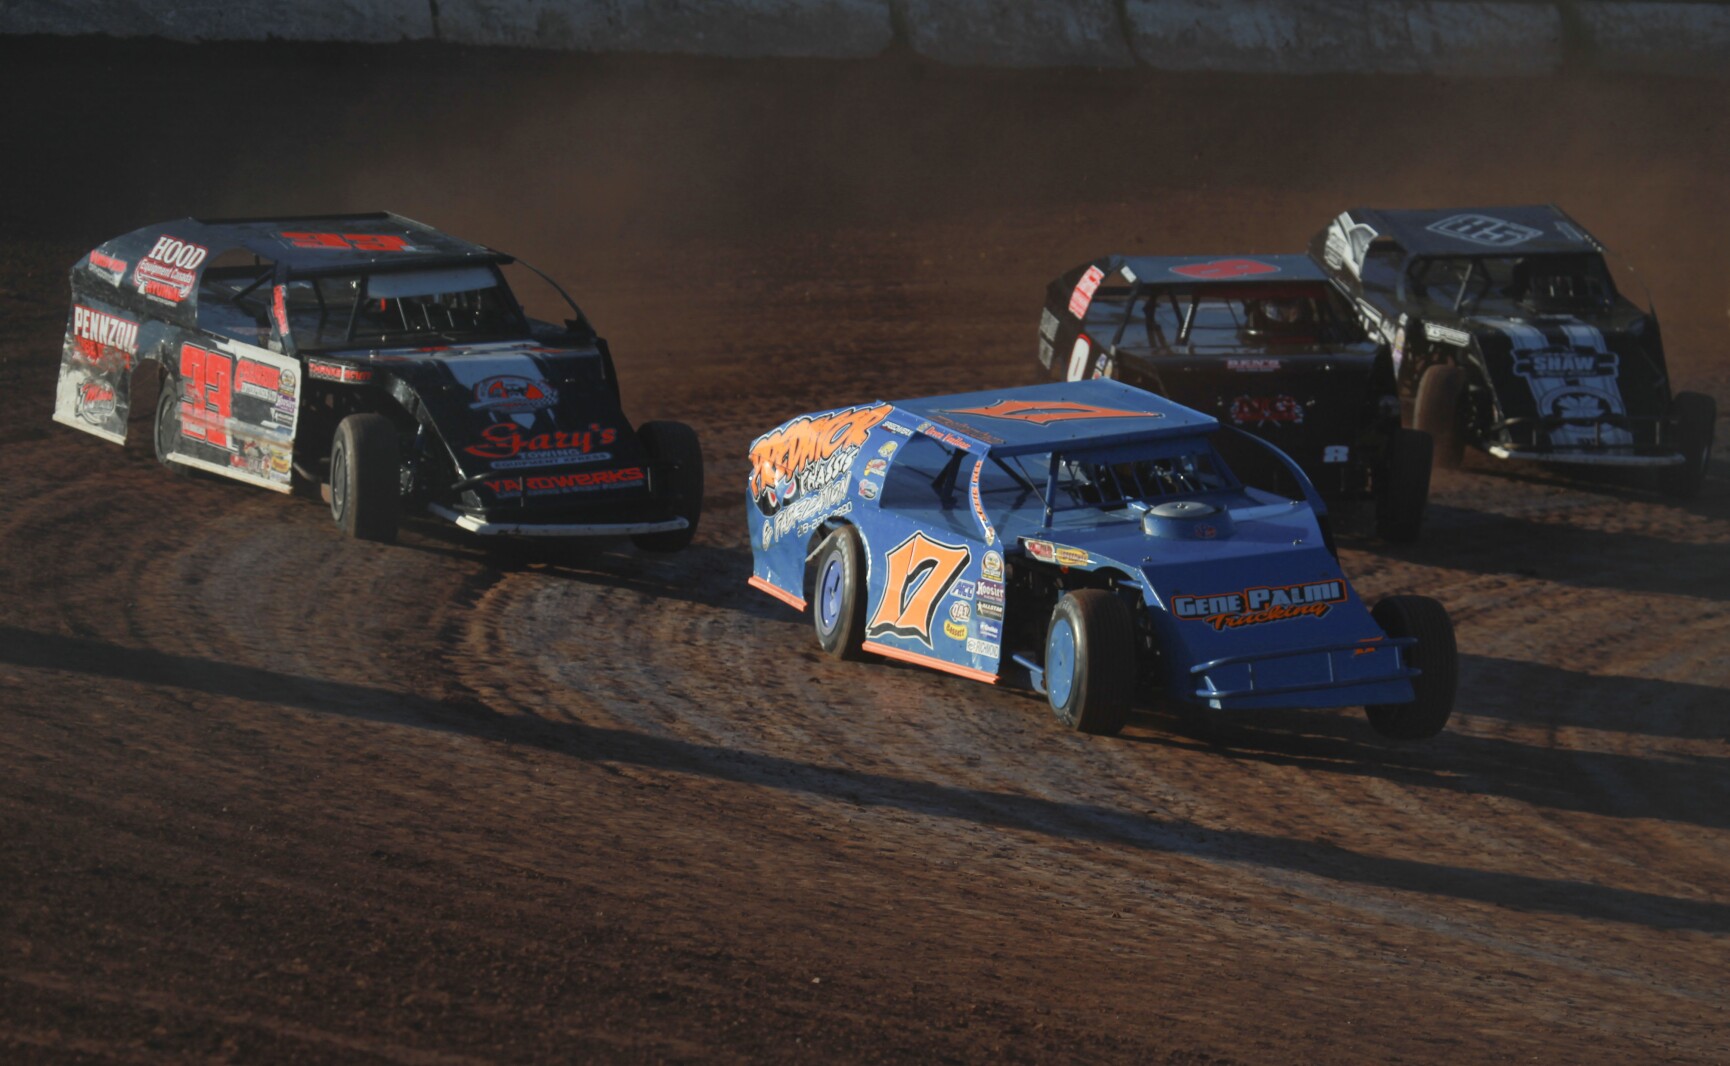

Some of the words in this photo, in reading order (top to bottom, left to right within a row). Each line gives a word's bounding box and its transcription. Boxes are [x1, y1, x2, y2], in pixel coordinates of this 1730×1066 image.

[148, 235, 207, 270] HOOD
[74, 305, 139, 355] PENNZOIL
[1532, 355, 1595, 371] SHAW
[180, 341, 233, 454] 33
[465, 422, 617, 459] Gary's
[518, 448, 581, 460] TOWING
[866, 530, 972, 650] 17
[976, 582, 1004, 598] Hoosier
[1204, 601, 1331, 631] Trucking
